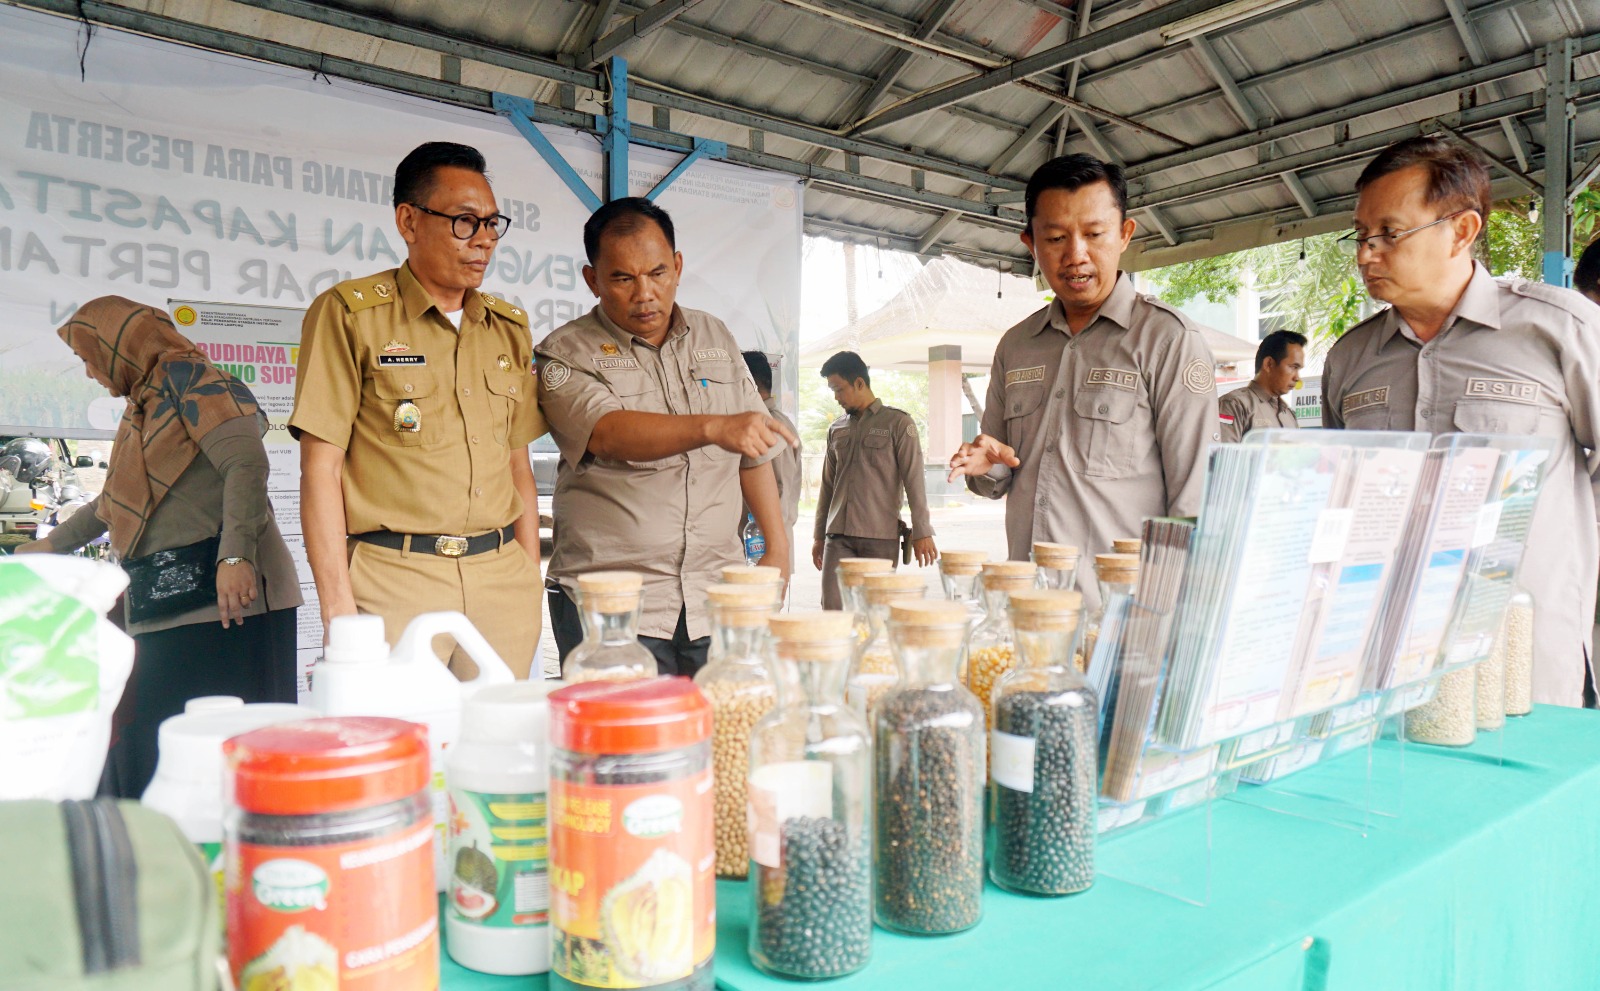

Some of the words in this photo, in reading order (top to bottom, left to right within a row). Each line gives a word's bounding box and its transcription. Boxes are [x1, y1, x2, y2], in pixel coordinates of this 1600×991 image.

[1092, 372, 1134, 385] BSIP
[1472, 381, 1536, 397] BSIP
[1296, 396, 1318, 406] ALUR
[1295, 406, 1321, 418] BENIH
